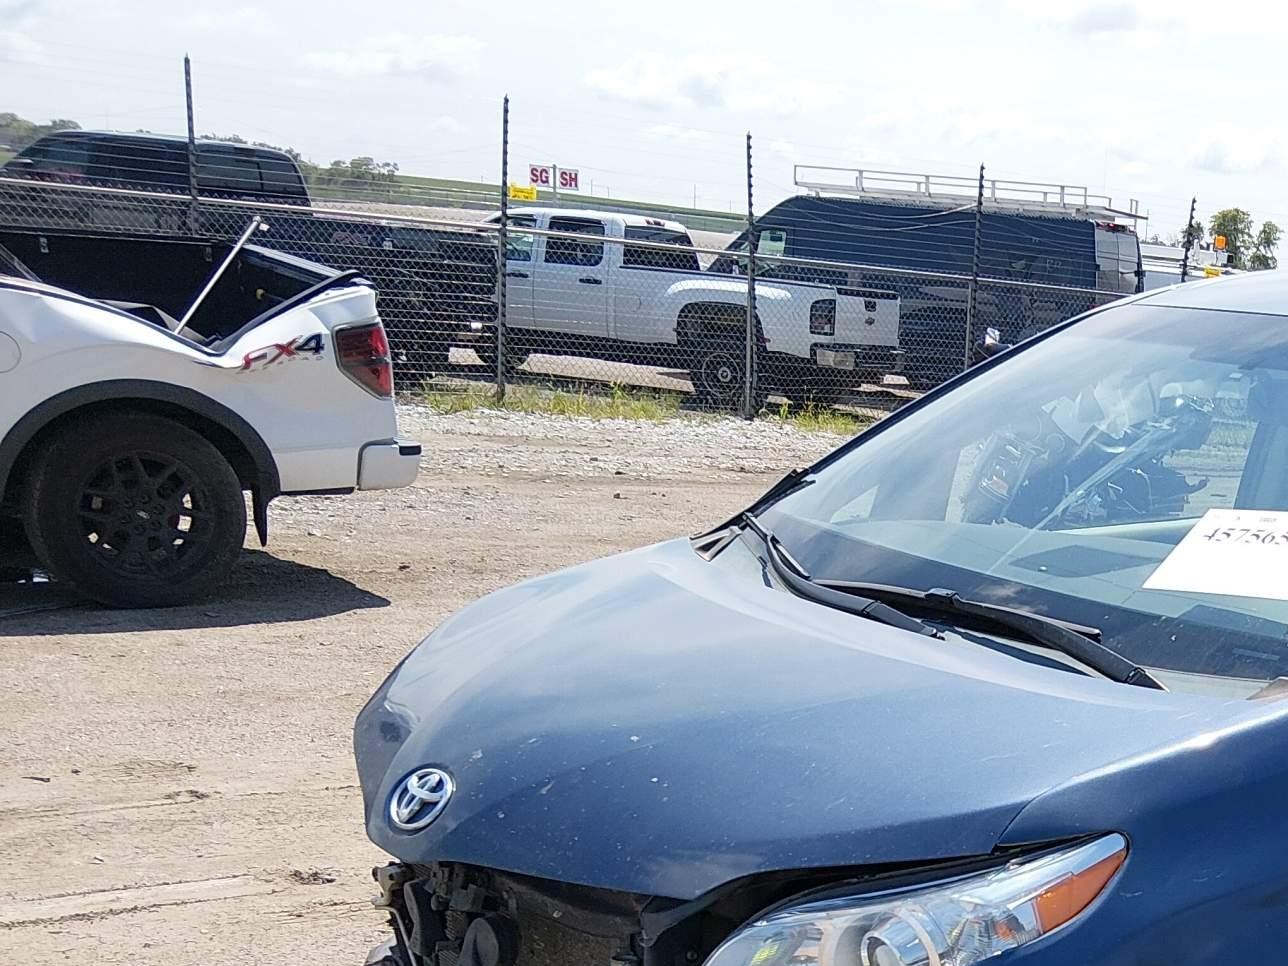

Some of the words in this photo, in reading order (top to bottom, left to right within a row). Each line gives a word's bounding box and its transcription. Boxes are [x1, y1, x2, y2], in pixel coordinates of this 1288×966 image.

[530, 167, 550, 184] SG
[560, 171, 578, 188] SH
[240, 332, 325, 371] FX4
